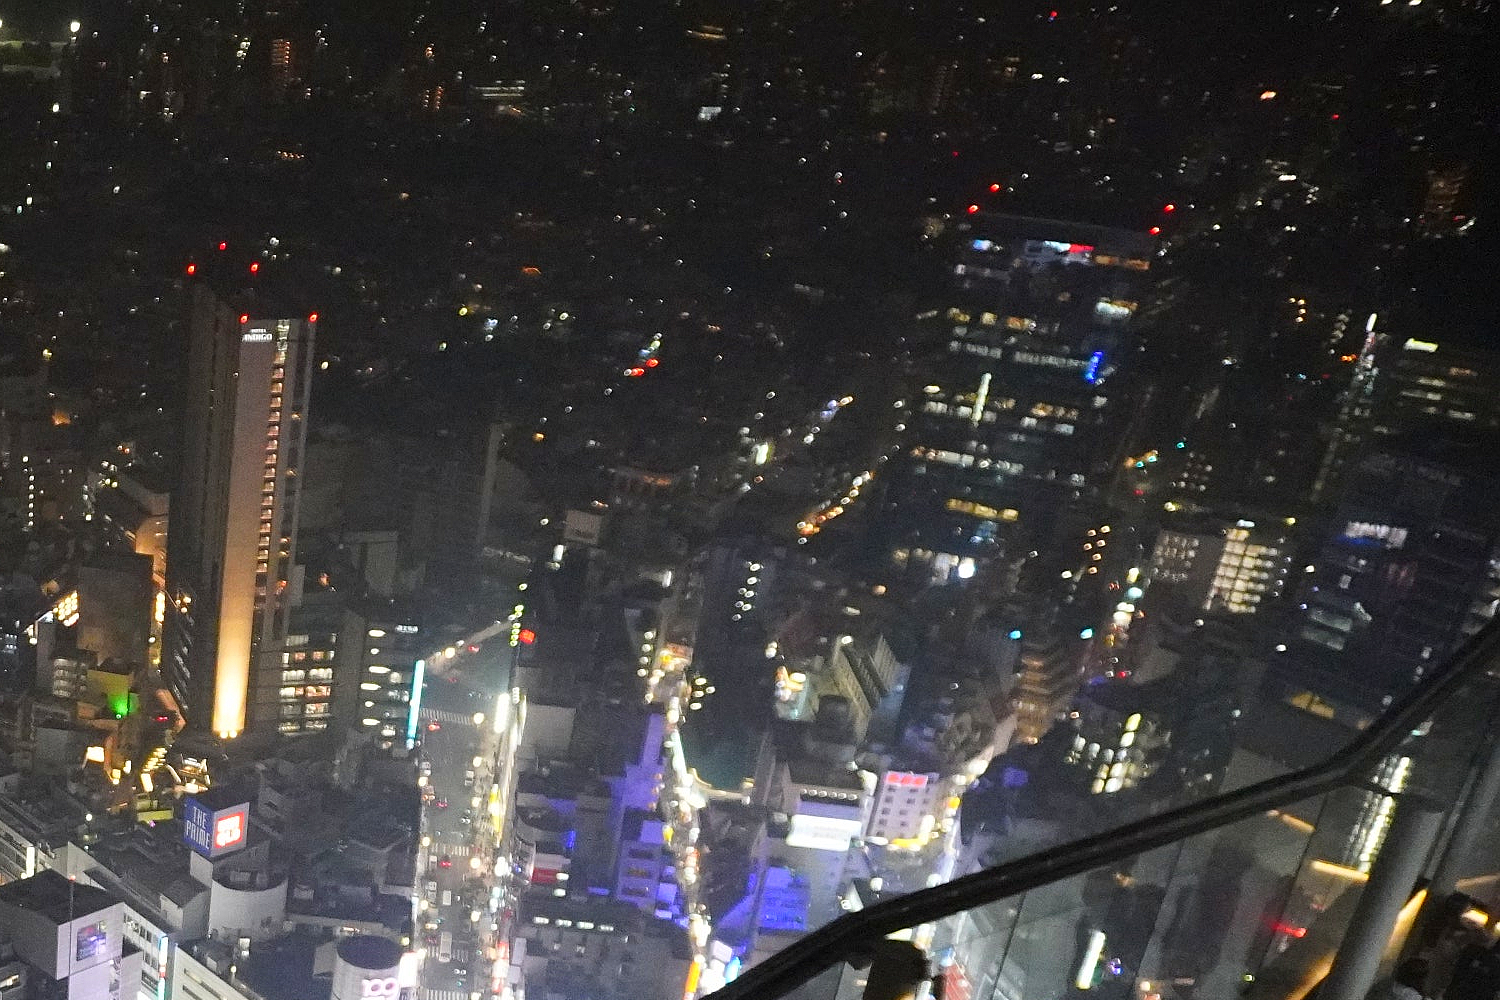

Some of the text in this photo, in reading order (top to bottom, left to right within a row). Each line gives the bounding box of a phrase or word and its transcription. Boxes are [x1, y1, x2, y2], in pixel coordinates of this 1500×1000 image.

[241, 333, 273, 342] INDIGO
[193, 806, 208, 829] THE
[186, 820, 211, 850] PRIME
